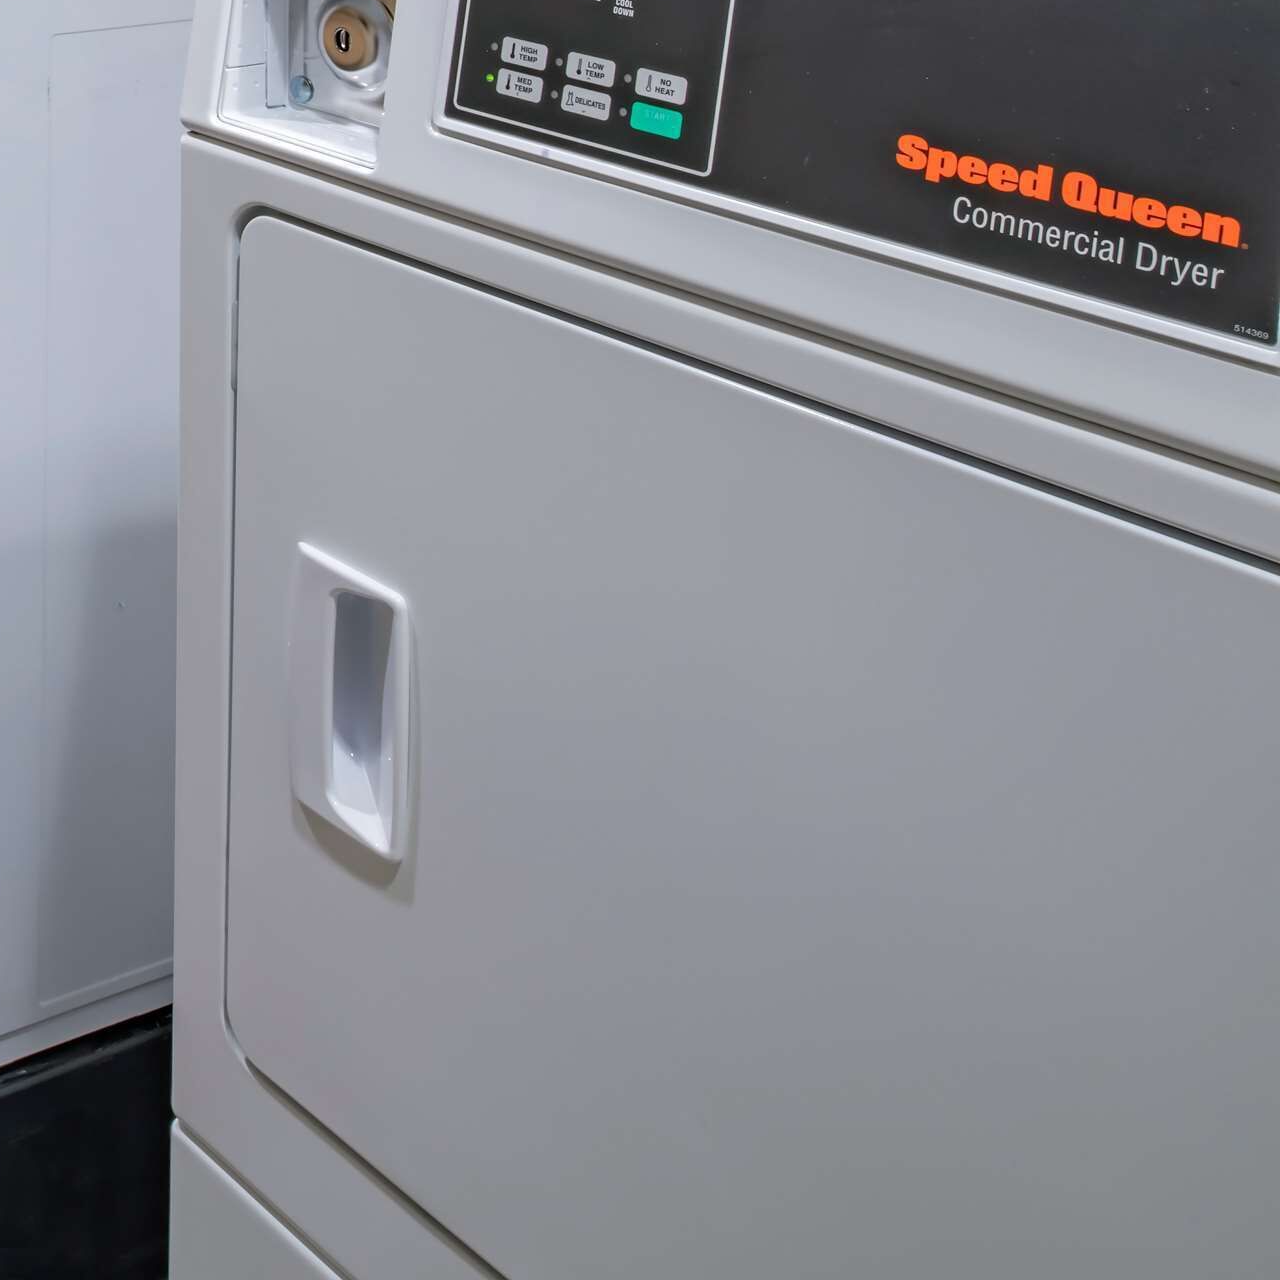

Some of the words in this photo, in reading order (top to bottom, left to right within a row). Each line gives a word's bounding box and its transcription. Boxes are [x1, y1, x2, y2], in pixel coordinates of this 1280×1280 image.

[612, 6, 634, 18] DOWN
[520, 45, 538, 55] HIGH
[519, 53, 538, 63] TEMP
[587, 61, 605, 71] LOW
[585, 69, 605, 80] TEMP
[517, 76, 533, 86] MED
[659, 78, 672, 87] NO
[514, 84, 533, 94] TEMP
[654, 87, 676, 98] HEAT
[574, 96, 606, 111] DELICATES
[896, 133, 1054, 202] Speed
[1061, 171, 1241, 248] Queen
[953, 196, 1124, 265] Commercial
[1135, 241, 1225, 289] Dryer
[1233, 324, 1269, 340] 514369
